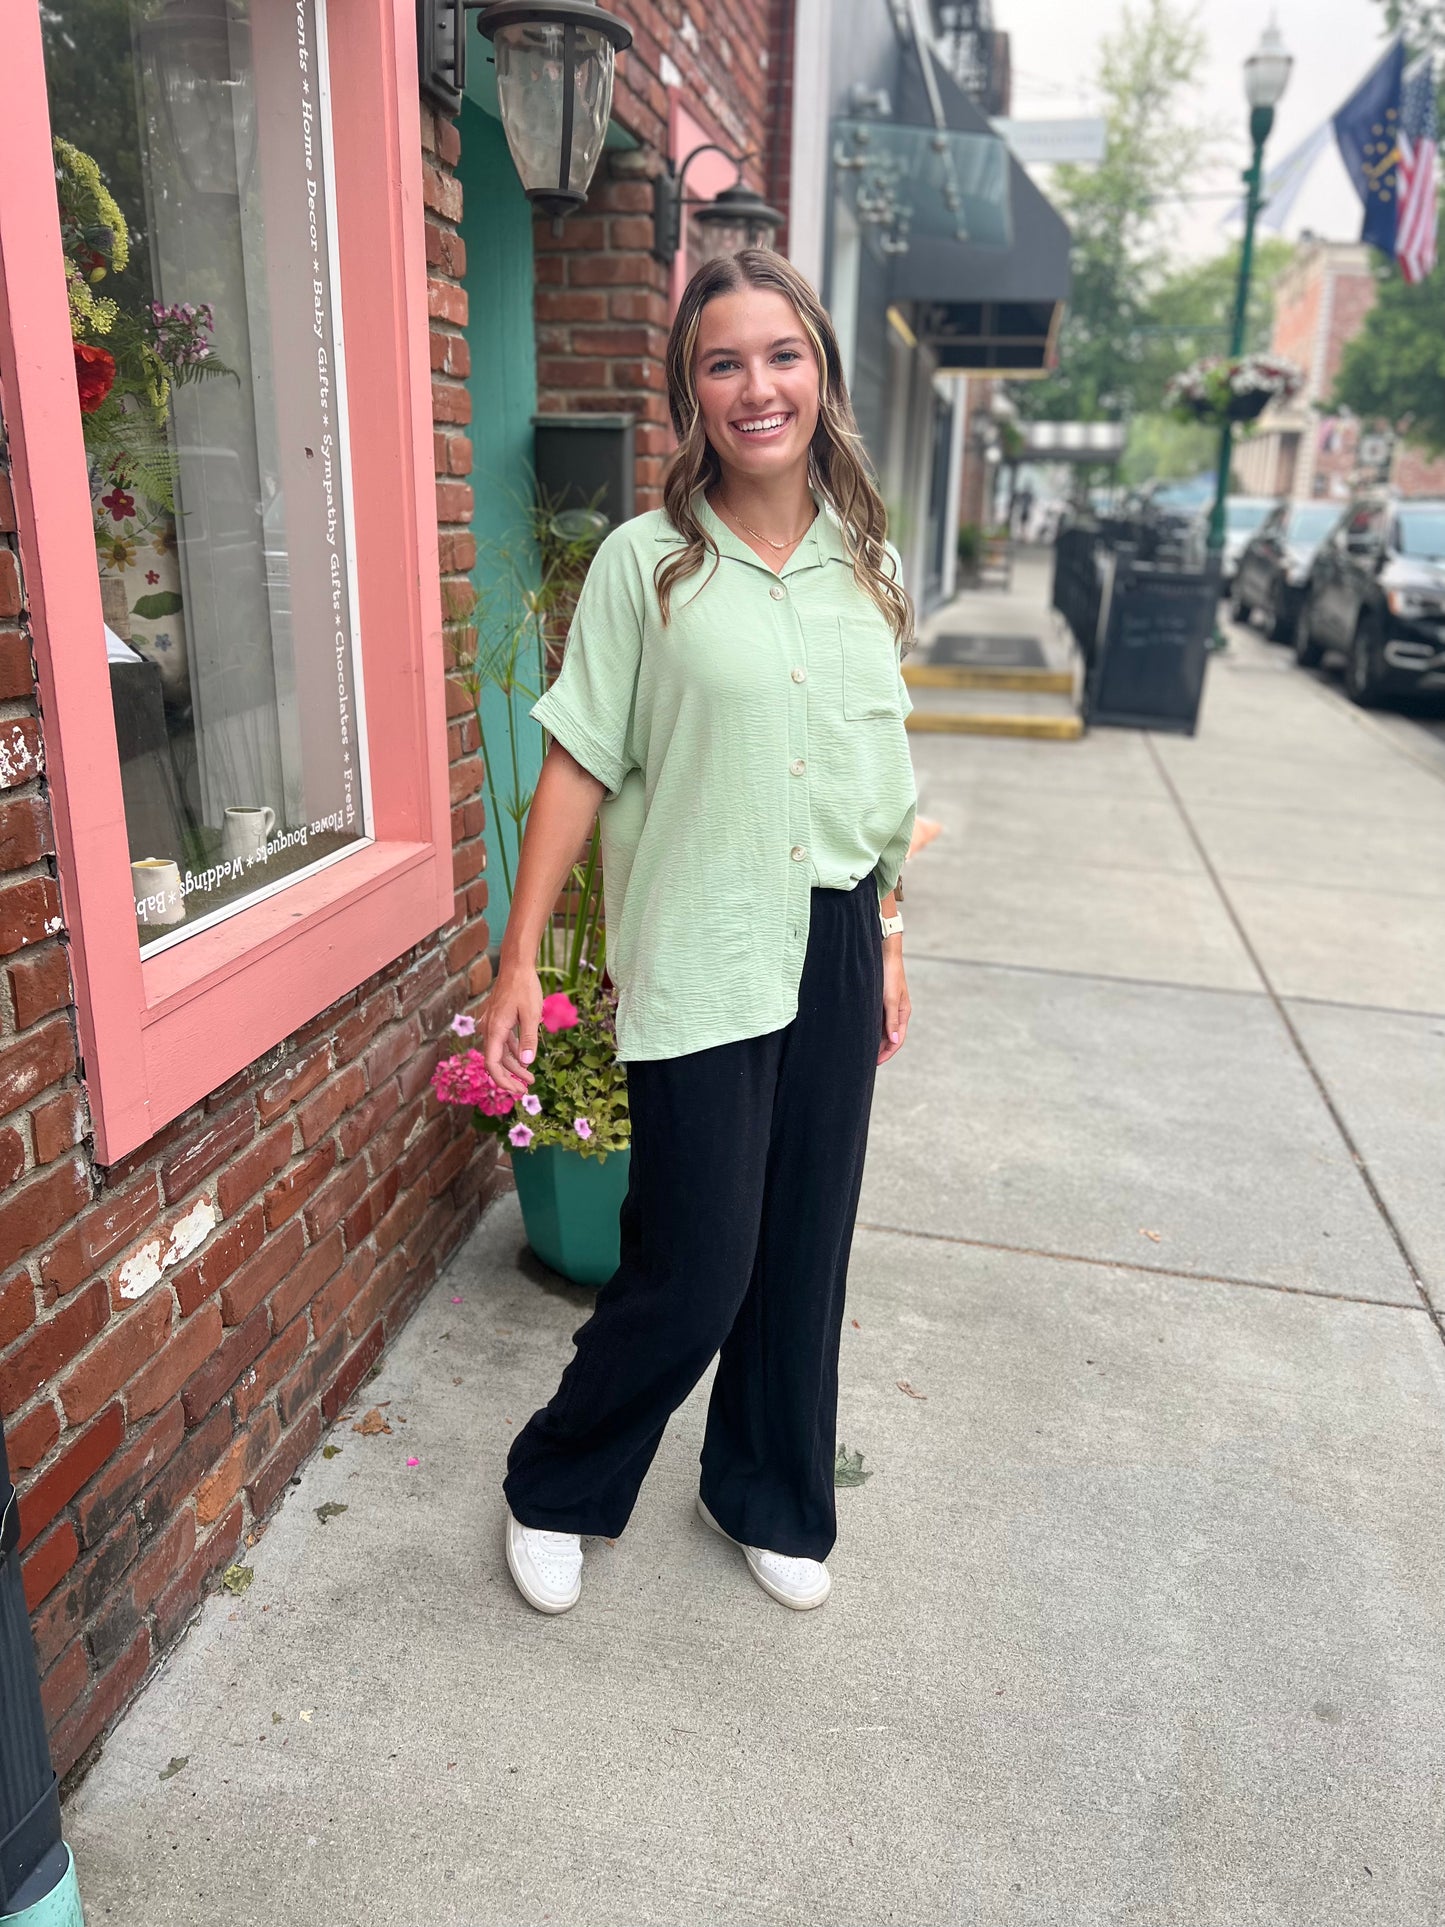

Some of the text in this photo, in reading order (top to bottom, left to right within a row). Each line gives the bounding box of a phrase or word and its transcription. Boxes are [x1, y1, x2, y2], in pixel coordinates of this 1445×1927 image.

[296, 0, 355, 825] vents Home Decor Baby Gifts Sympathy Gifts Chocolates Fresh
[309, 810, 344, 832] Flower
[256, 826, 308, 864] Bouquets
[180, 856, 244, 899] Weddings
